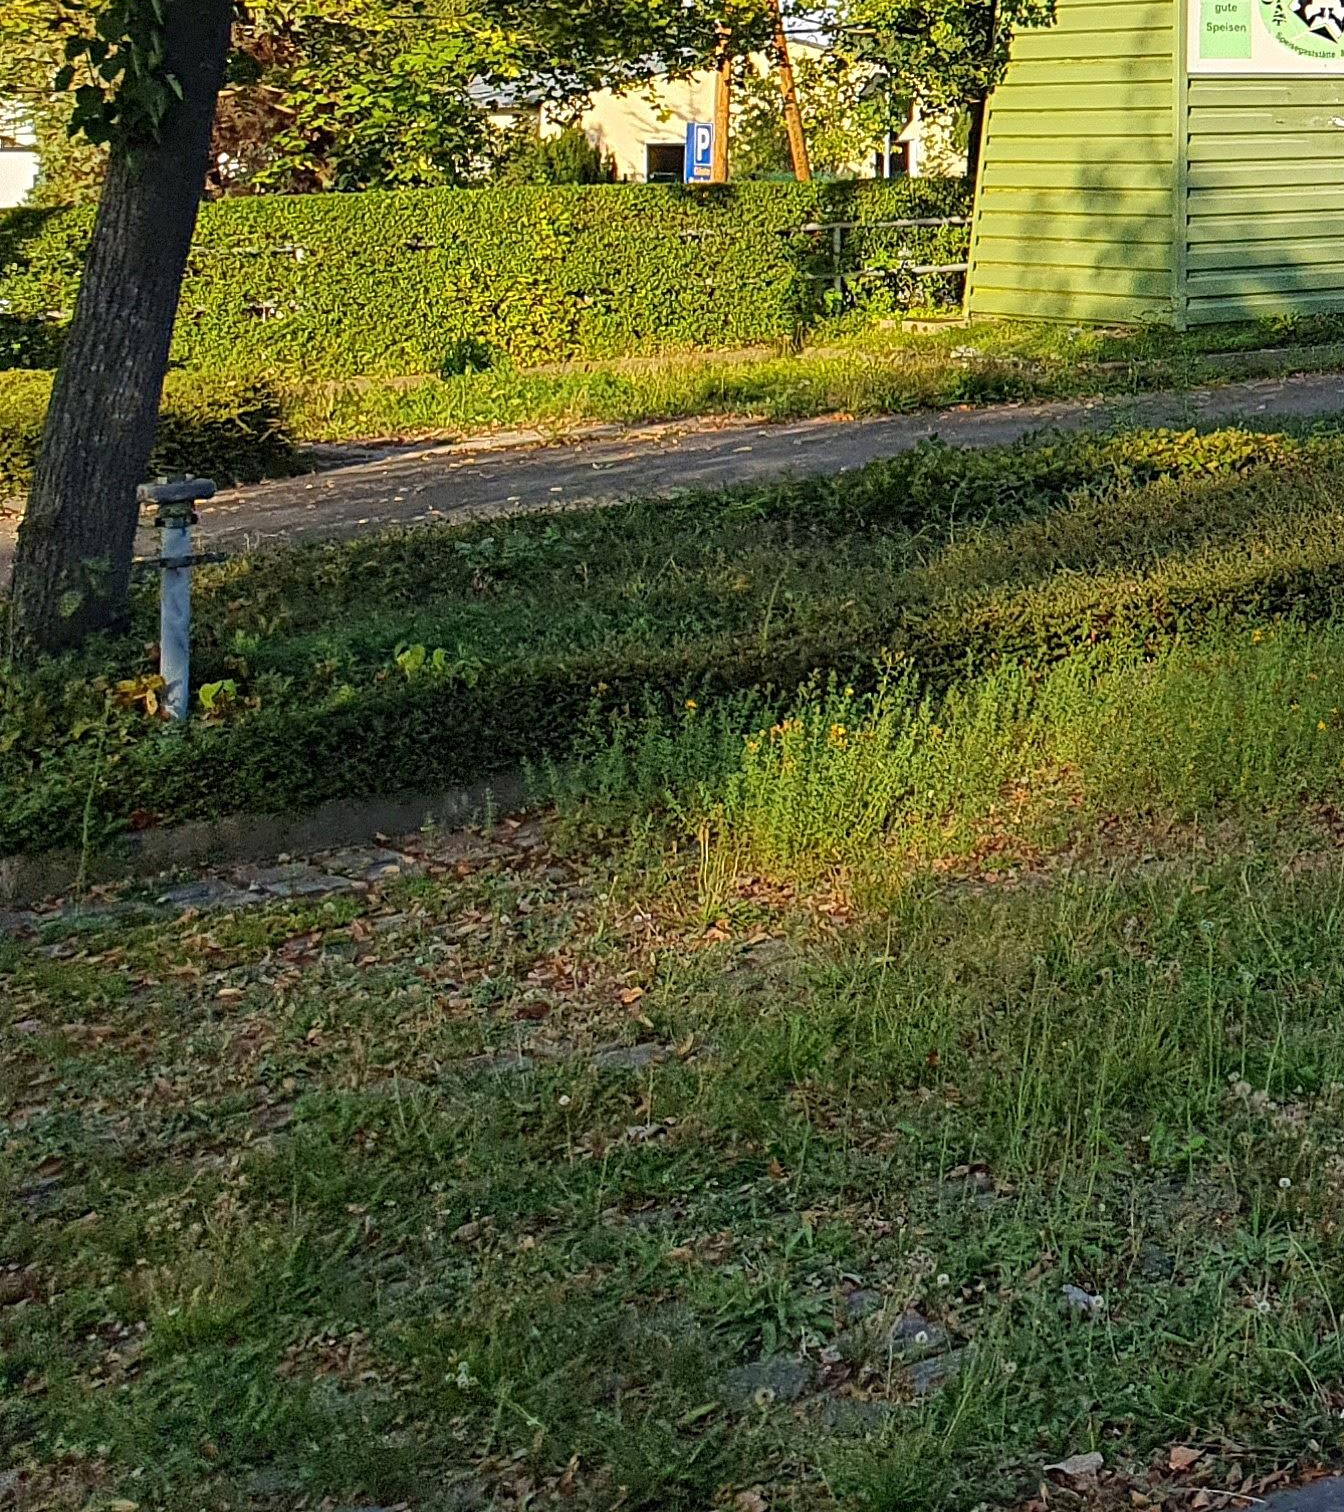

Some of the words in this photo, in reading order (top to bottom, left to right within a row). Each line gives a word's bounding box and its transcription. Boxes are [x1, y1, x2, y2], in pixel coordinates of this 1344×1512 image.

[1215, 3, 1237, 14] gute
[1206, 22, 1247, 34] Speisen
[697, 128, 710, 161] P
